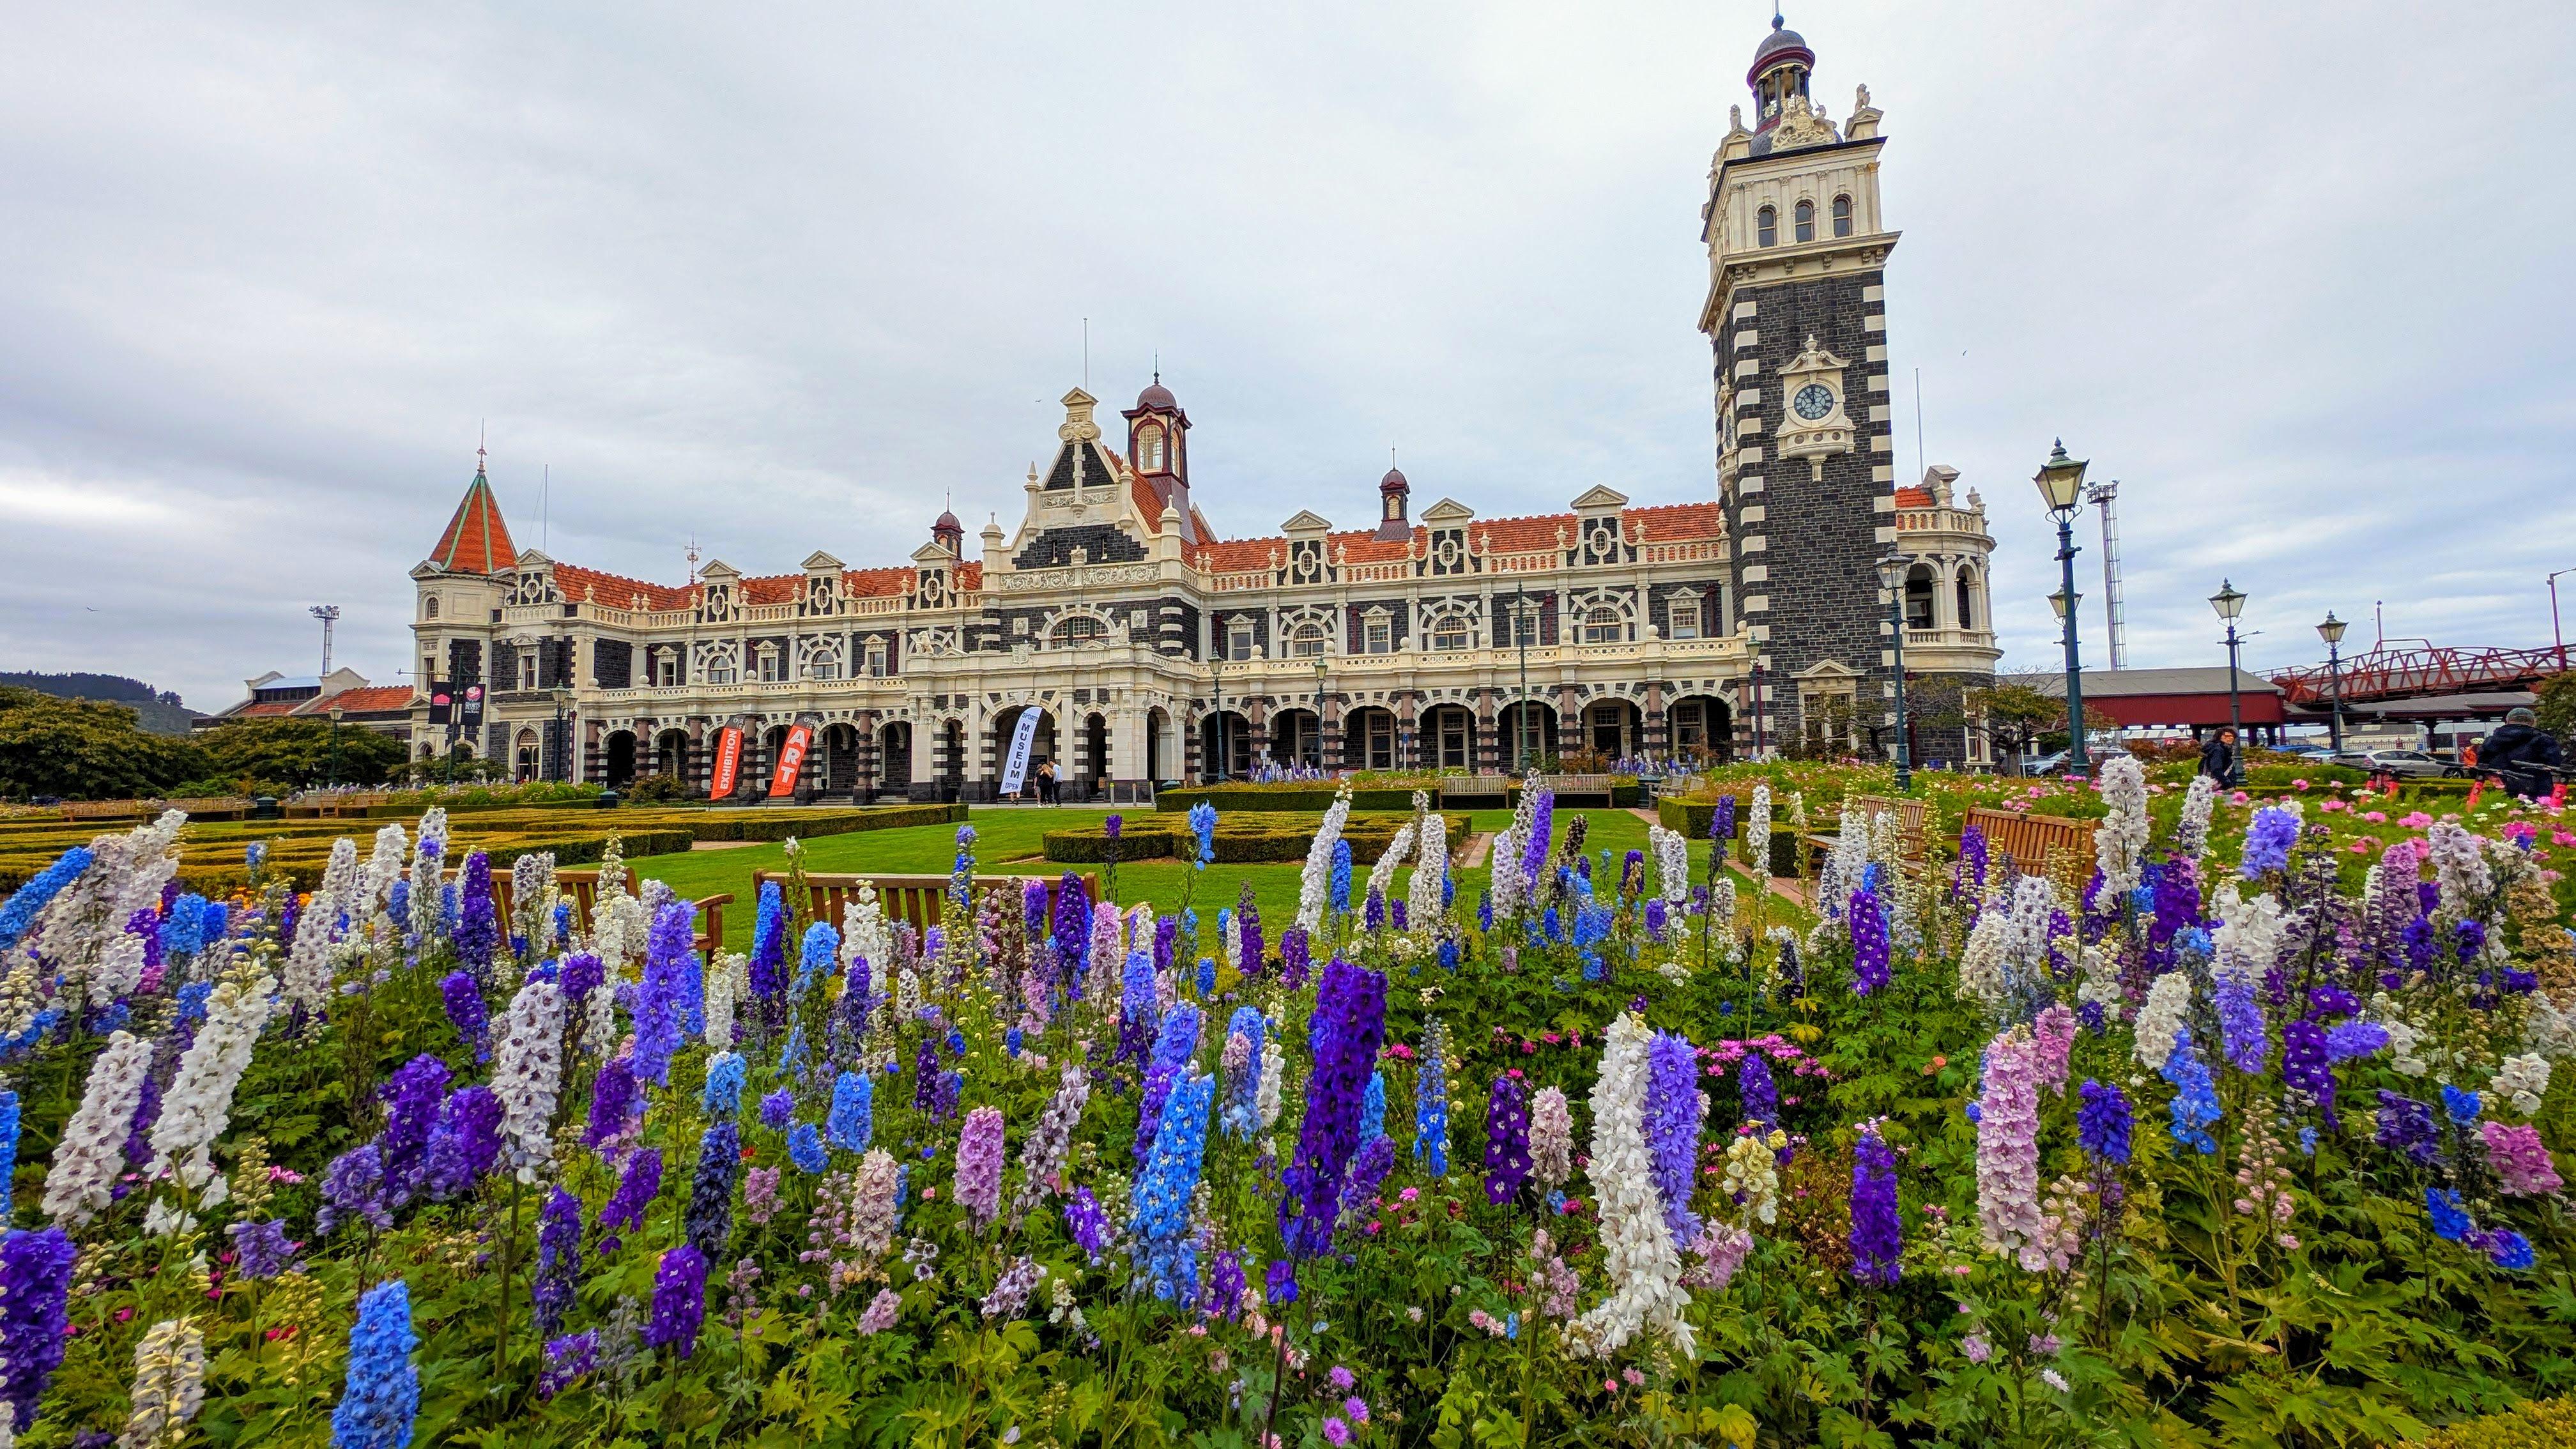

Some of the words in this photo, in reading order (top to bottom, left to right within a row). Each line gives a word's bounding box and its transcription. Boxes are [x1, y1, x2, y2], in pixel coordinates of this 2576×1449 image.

[1022, 712, 1038, 723] SPORTS
[719, 730, 737, 790] EXHIBITION
[781, 730, 806, 783] ART
[1010, 723, 1031, 779] MUSEUM
